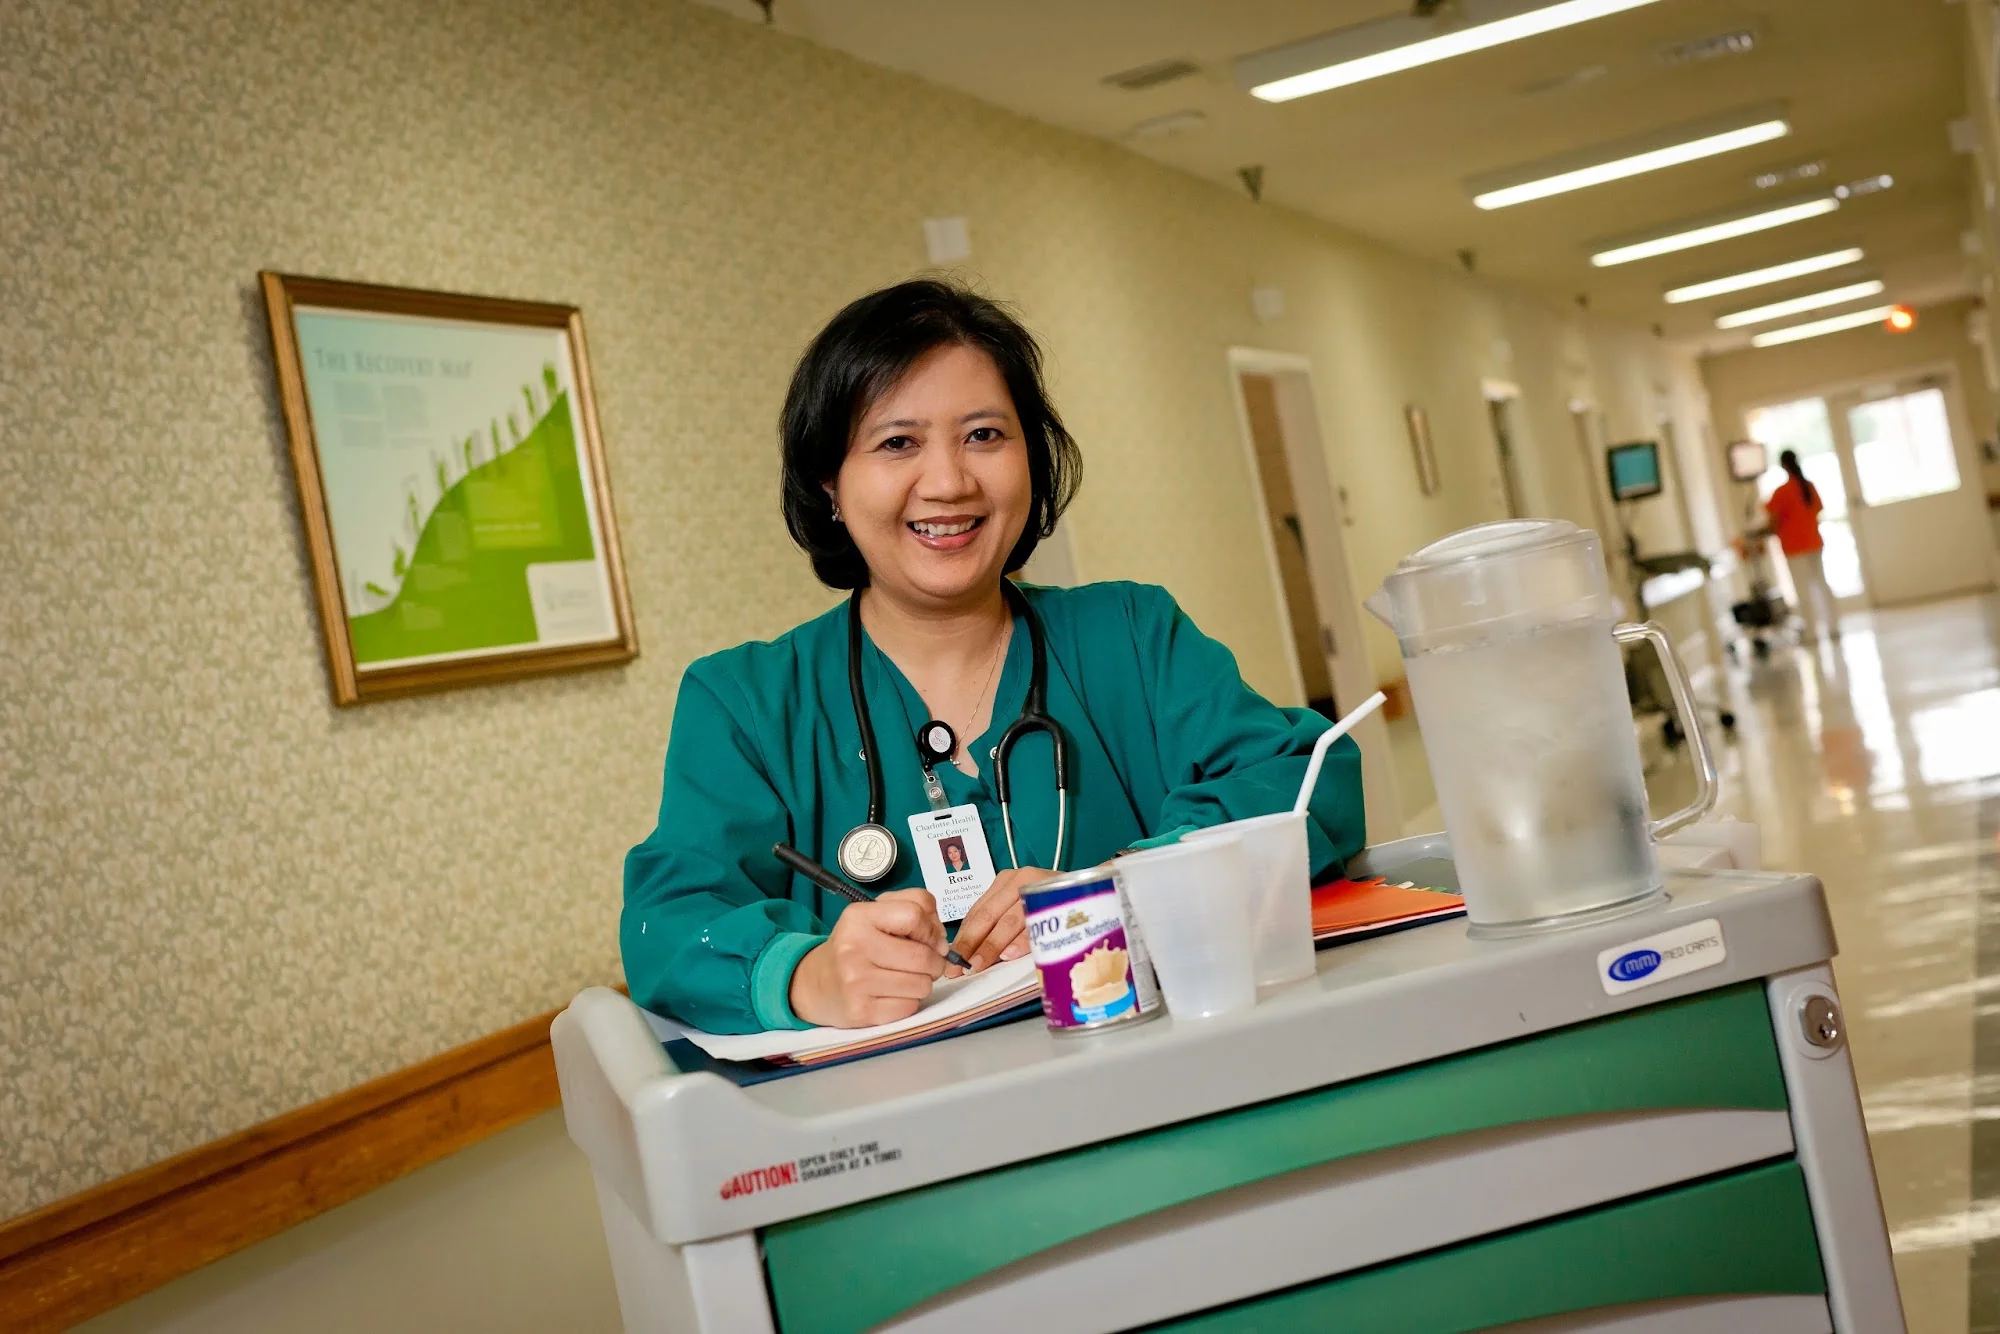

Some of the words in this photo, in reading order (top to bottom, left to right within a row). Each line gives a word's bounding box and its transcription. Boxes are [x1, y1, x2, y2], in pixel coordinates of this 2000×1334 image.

[915, 820, 950, 833] Charlotte
[951, 815, 977, 826] Health
[927, 831, 944, 840] Care
[945, 827, 970, 837] Center
[948, 873, 974, 885] Rose
[944, 888, 960, 896] Rose
[1029, 916, 1060, 946] pro
